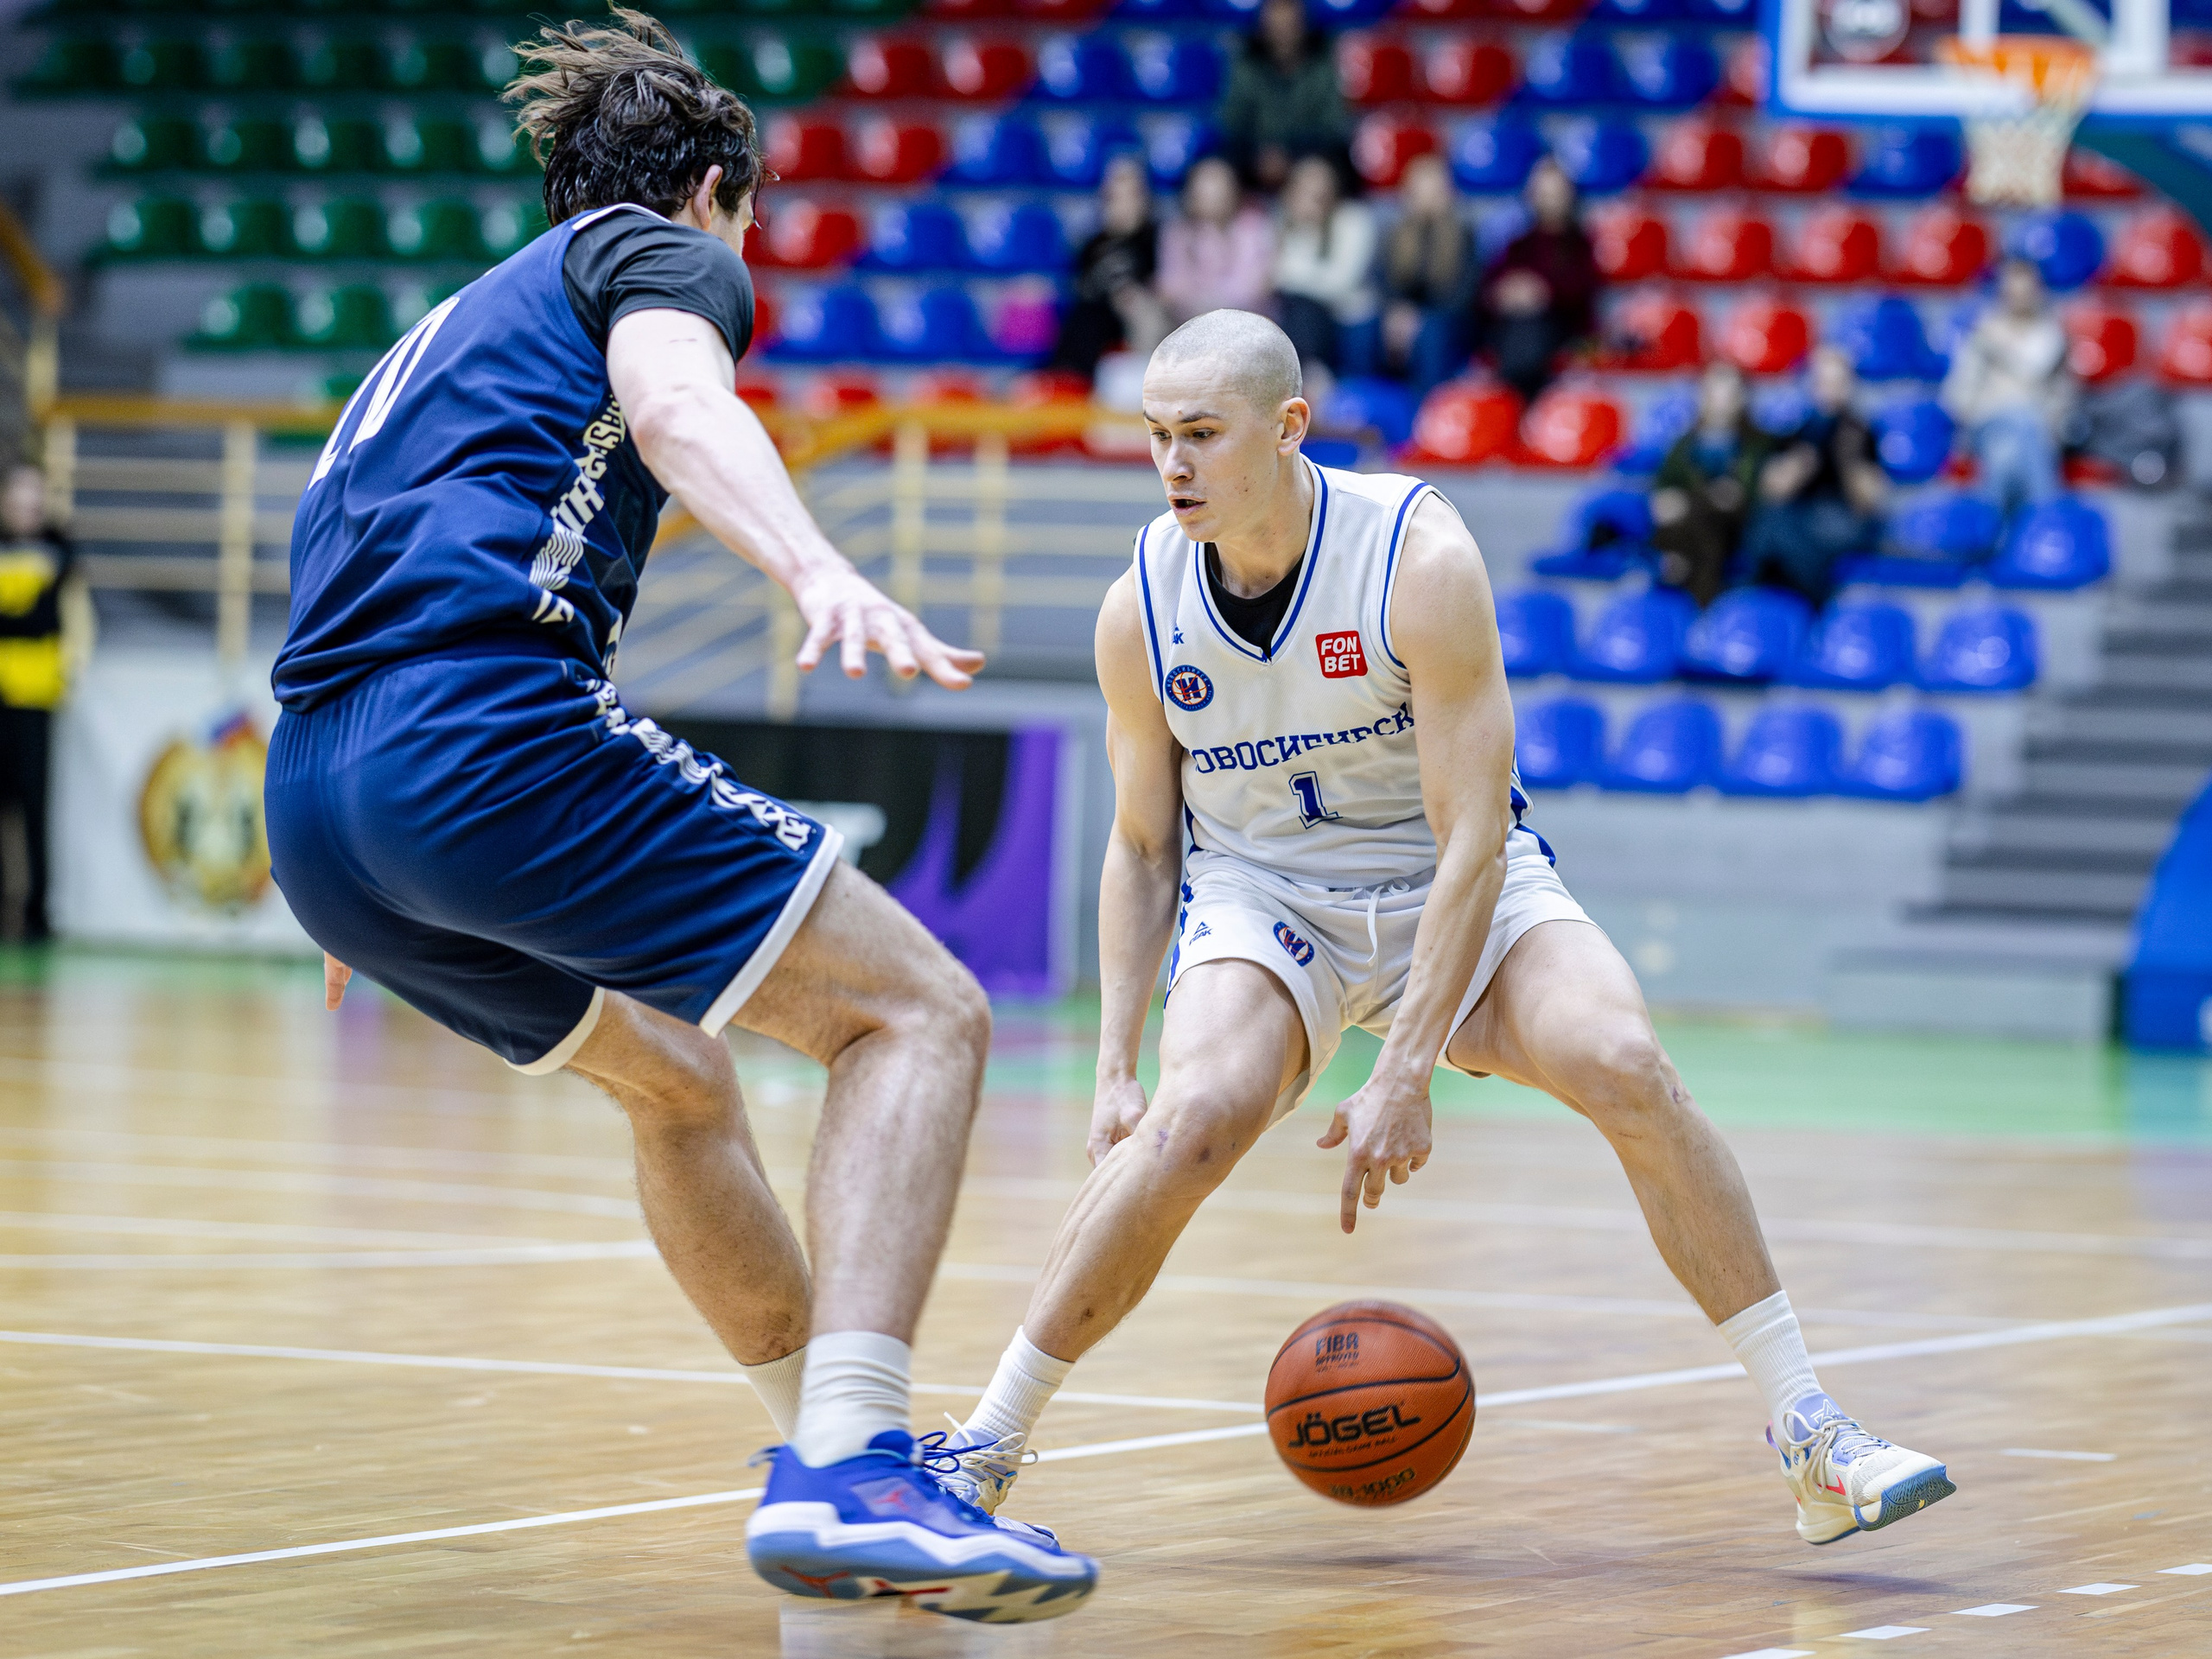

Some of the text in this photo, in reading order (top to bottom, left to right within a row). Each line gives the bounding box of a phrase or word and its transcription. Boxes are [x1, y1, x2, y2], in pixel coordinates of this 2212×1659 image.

[1320, 636, 1357, 656] FON
[1324, 653, 1361, 673] BET
[1186, 702, 1414, 774] ОВОСИБИРСК
[1288, 771, 1343, 830] 1
[1315, 1332, 1359, 1357] FIBA
[1287, 1405, 1421, 1447] JÖGEL
